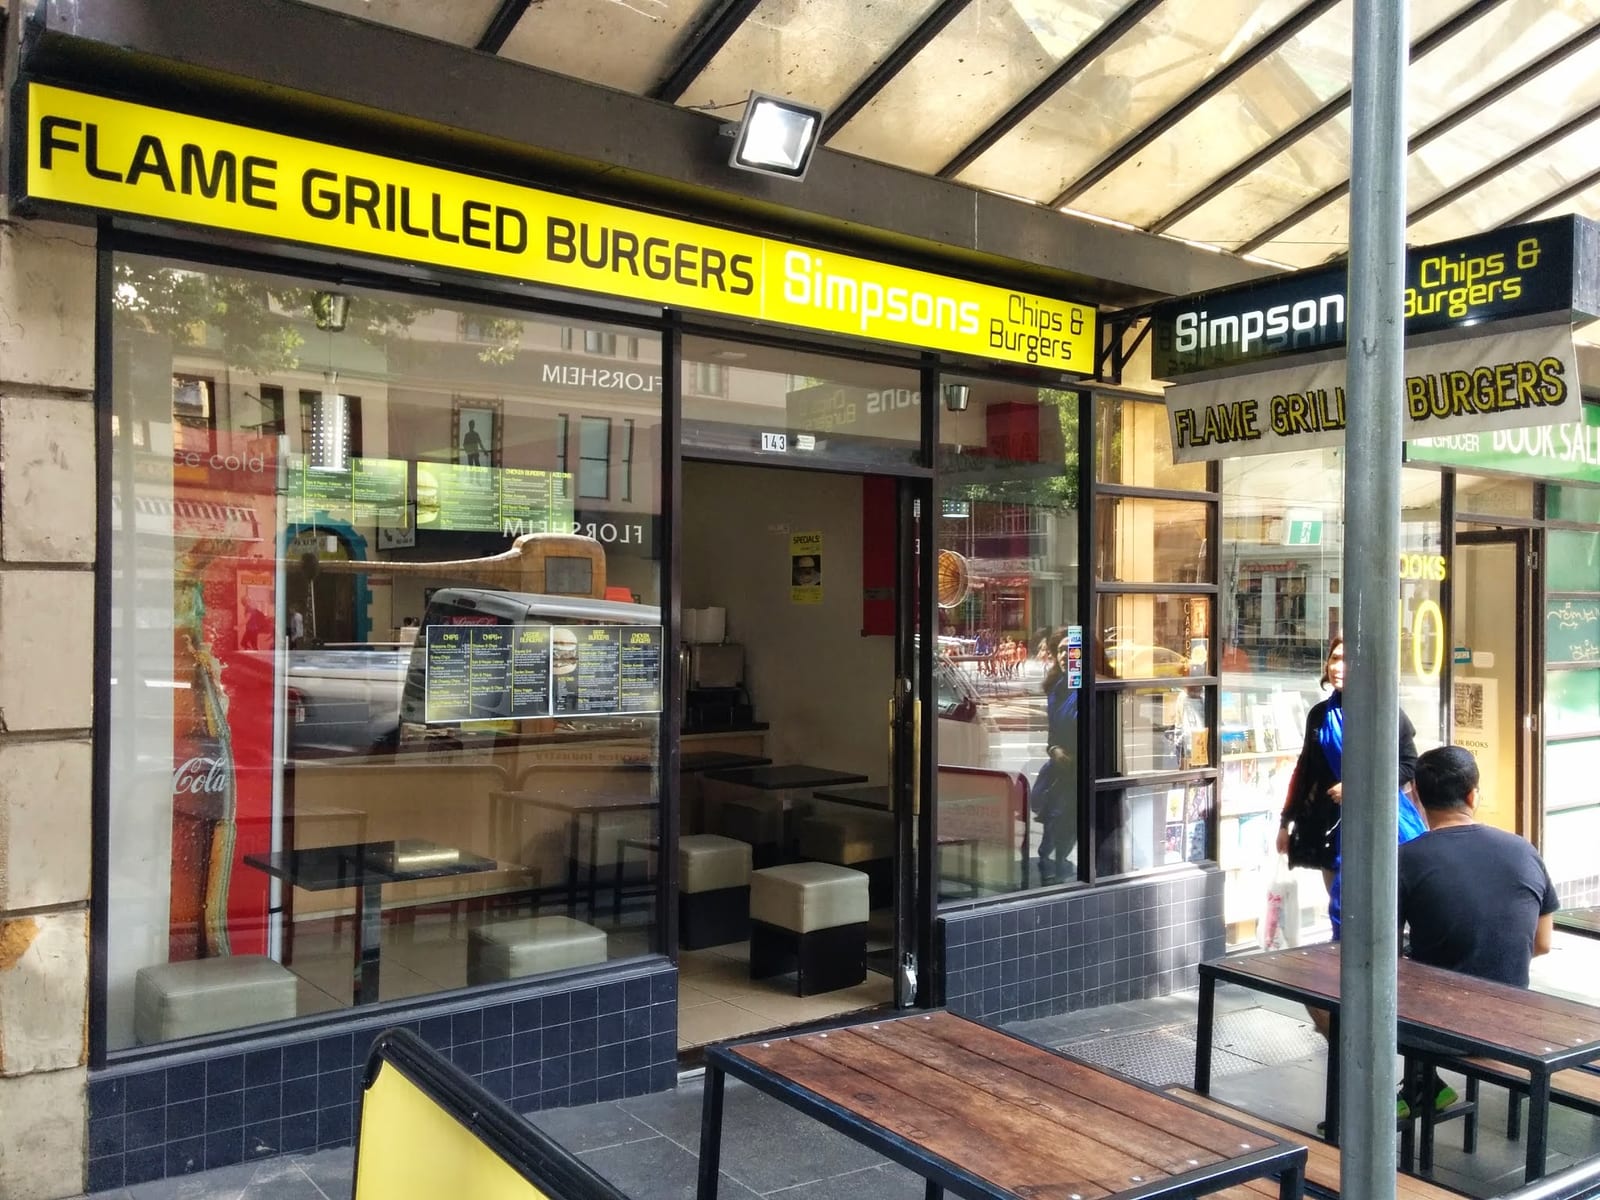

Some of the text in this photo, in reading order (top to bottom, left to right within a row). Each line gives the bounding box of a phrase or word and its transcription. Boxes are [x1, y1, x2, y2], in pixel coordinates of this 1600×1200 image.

[40, 114, 754, 296] FLAME GRILLED BURGERS
[1420, 237, 1541, 290] Chips &
[783, 249, 981, 334] Simpsons
[1404, 275, 1522, 319] Burgers
[1008, 294, 1084, 336] Chips &
[1175, 292, 1345, 353] Simpson
[989, 319, 1072, 363] Burgers
[1174, 357, 1568, 449] FLAME GRILL BURGERS
[173, 451, 264, 473] ce cold
[763, 434, 786, 450] 143
[1559, 422, 1600, 465] SAL
[792, 535, 820, 544] SPECIALS
[1399, 554, 1446, 582] OOKS
[1465, 740, 1489, 749] BOOKS
[171, 757, 228, 796] Cola
